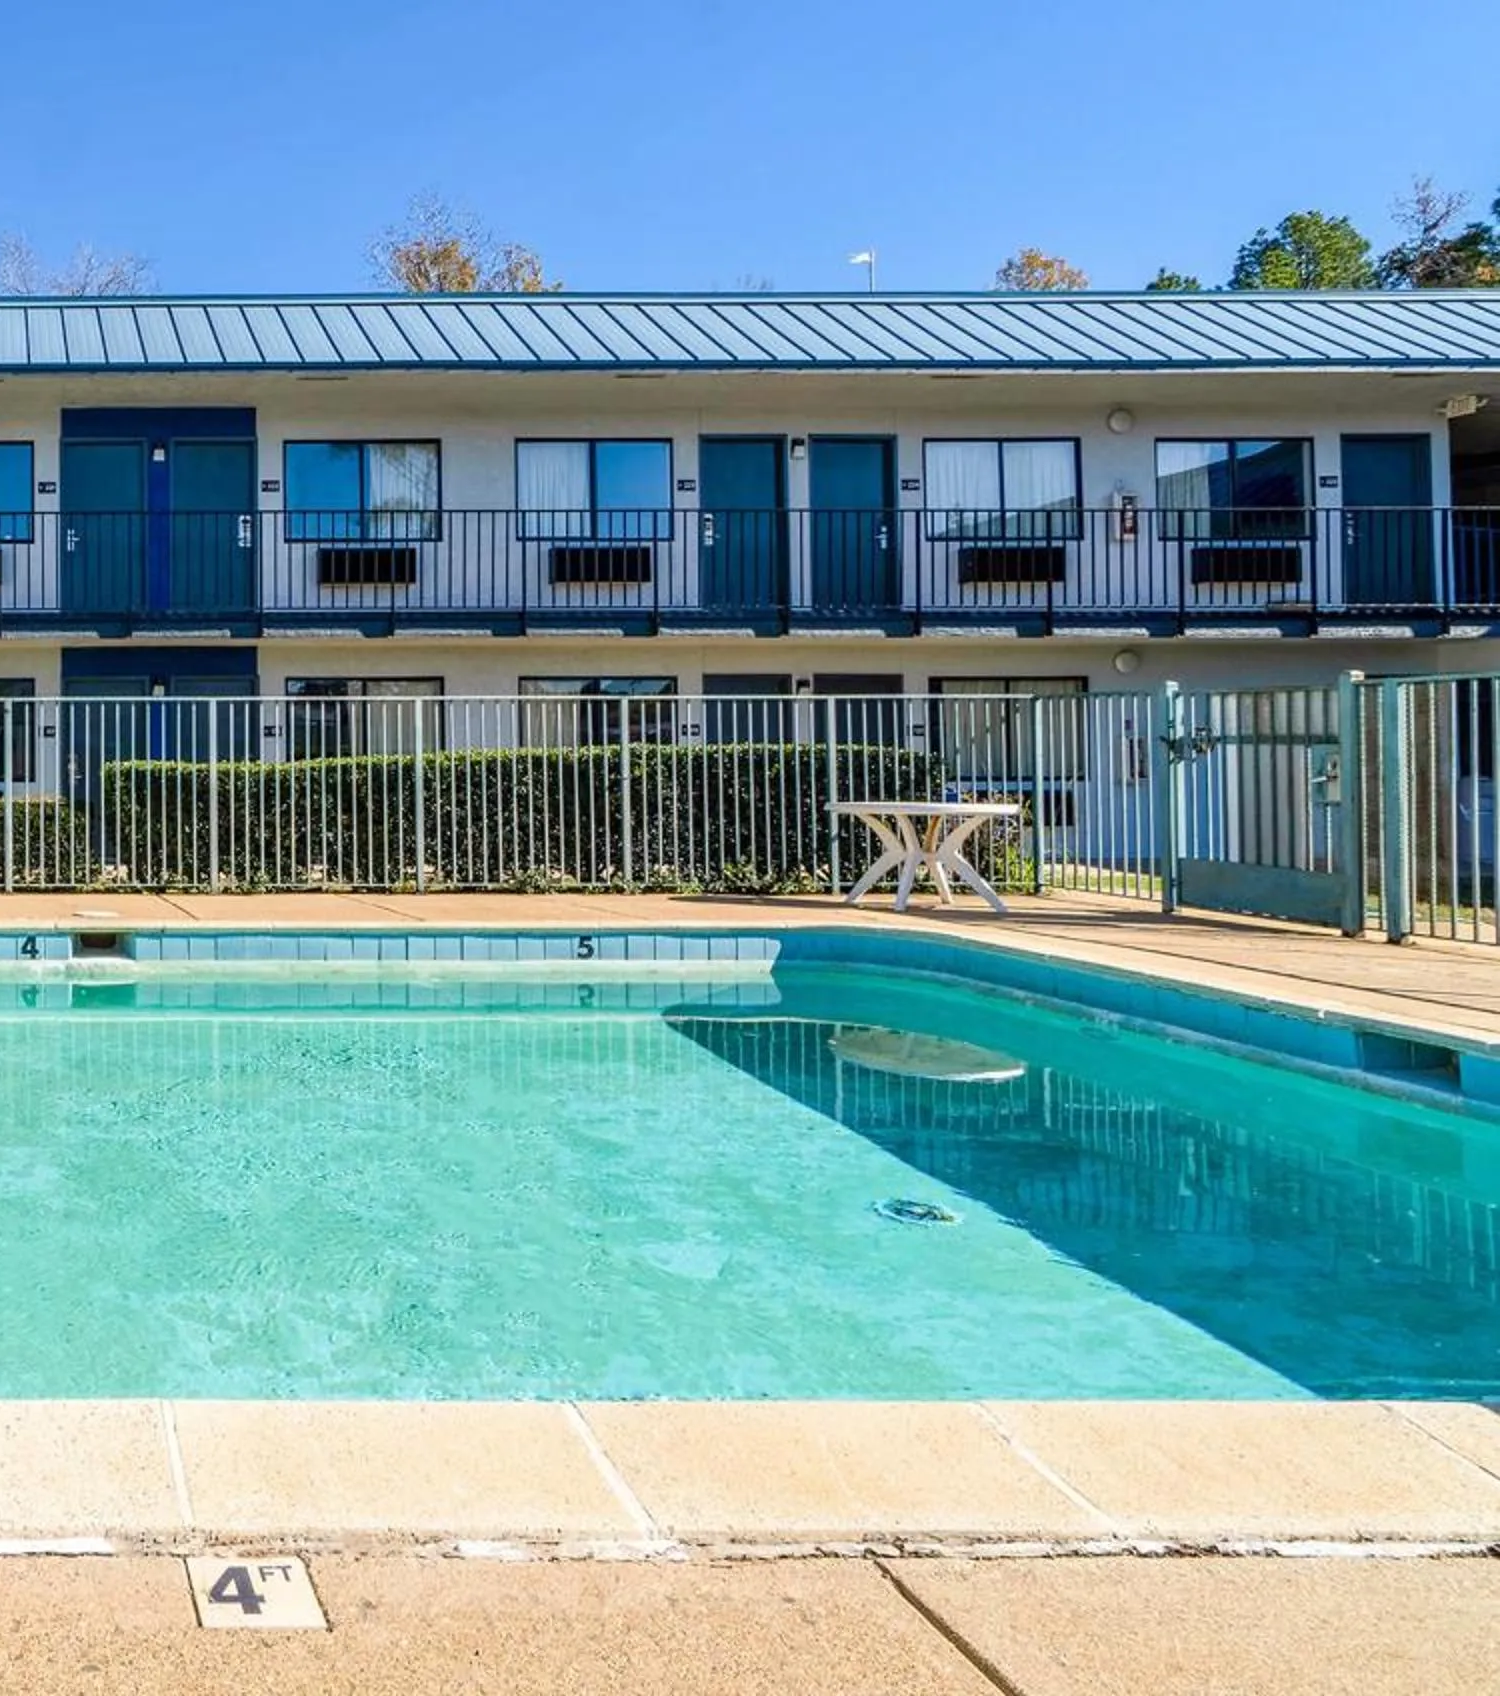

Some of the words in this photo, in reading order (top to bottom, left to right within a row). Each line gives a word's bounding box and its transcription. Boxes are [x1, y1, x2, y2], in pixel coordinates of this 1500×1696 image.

[20, 934, 40, 960] 4
[577, 935, 595, 959] 5
[208, 1565, 266, 1615] 4
[258, 1565, 292, 1582] FT
